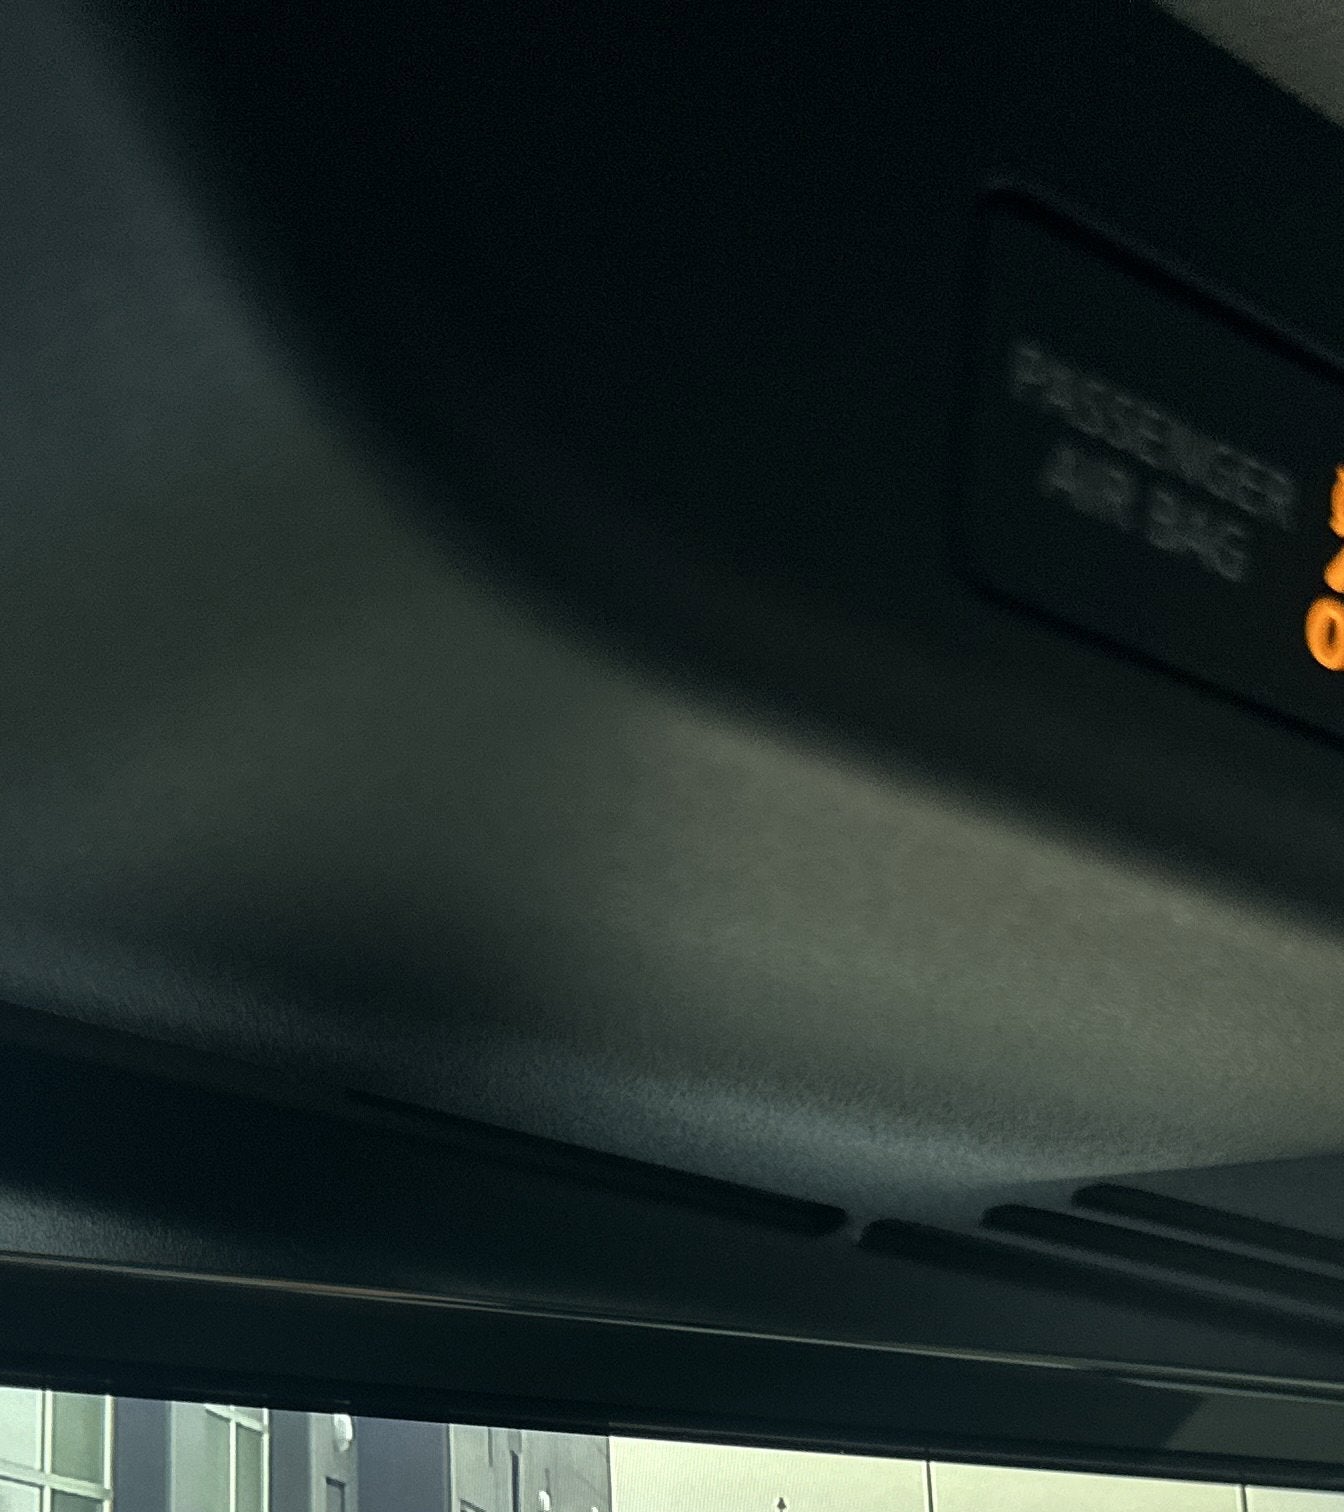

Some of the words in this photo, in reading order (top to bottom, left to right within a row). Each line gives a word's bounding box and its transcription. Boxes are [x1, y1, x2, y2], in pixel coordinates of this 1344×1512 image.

[1012, 342, 1292, 528] PASSENGER
[1041, 442, 1138, 530] AIR
[1148, 486, 1250, 582] BAG
